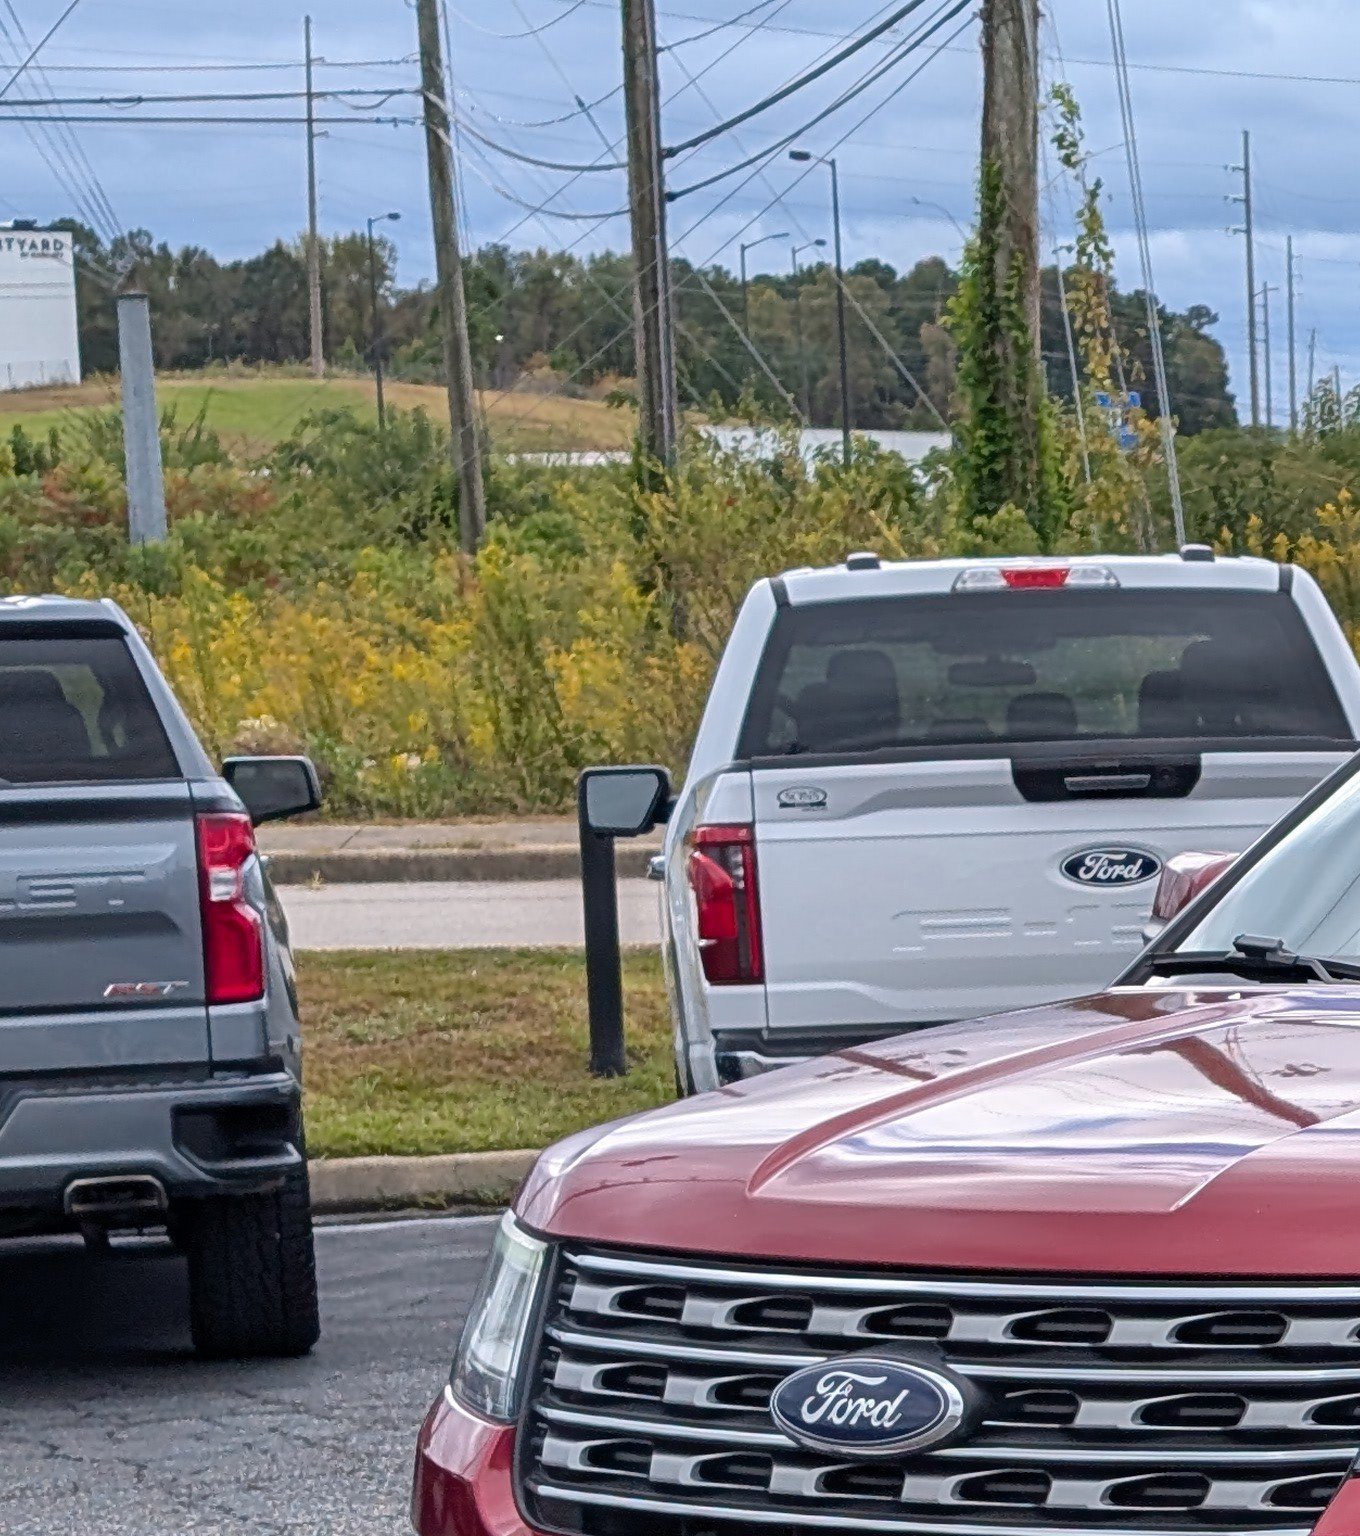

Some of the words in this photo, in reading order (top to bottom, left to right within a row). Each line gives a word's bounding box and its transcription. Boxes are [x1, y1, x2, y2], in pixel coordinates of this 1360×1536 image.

[0, 237, 64, 251] TYARD
[1078, 852, 1144, 880] Ford
[801, 1370, 910, 1428] Ford
